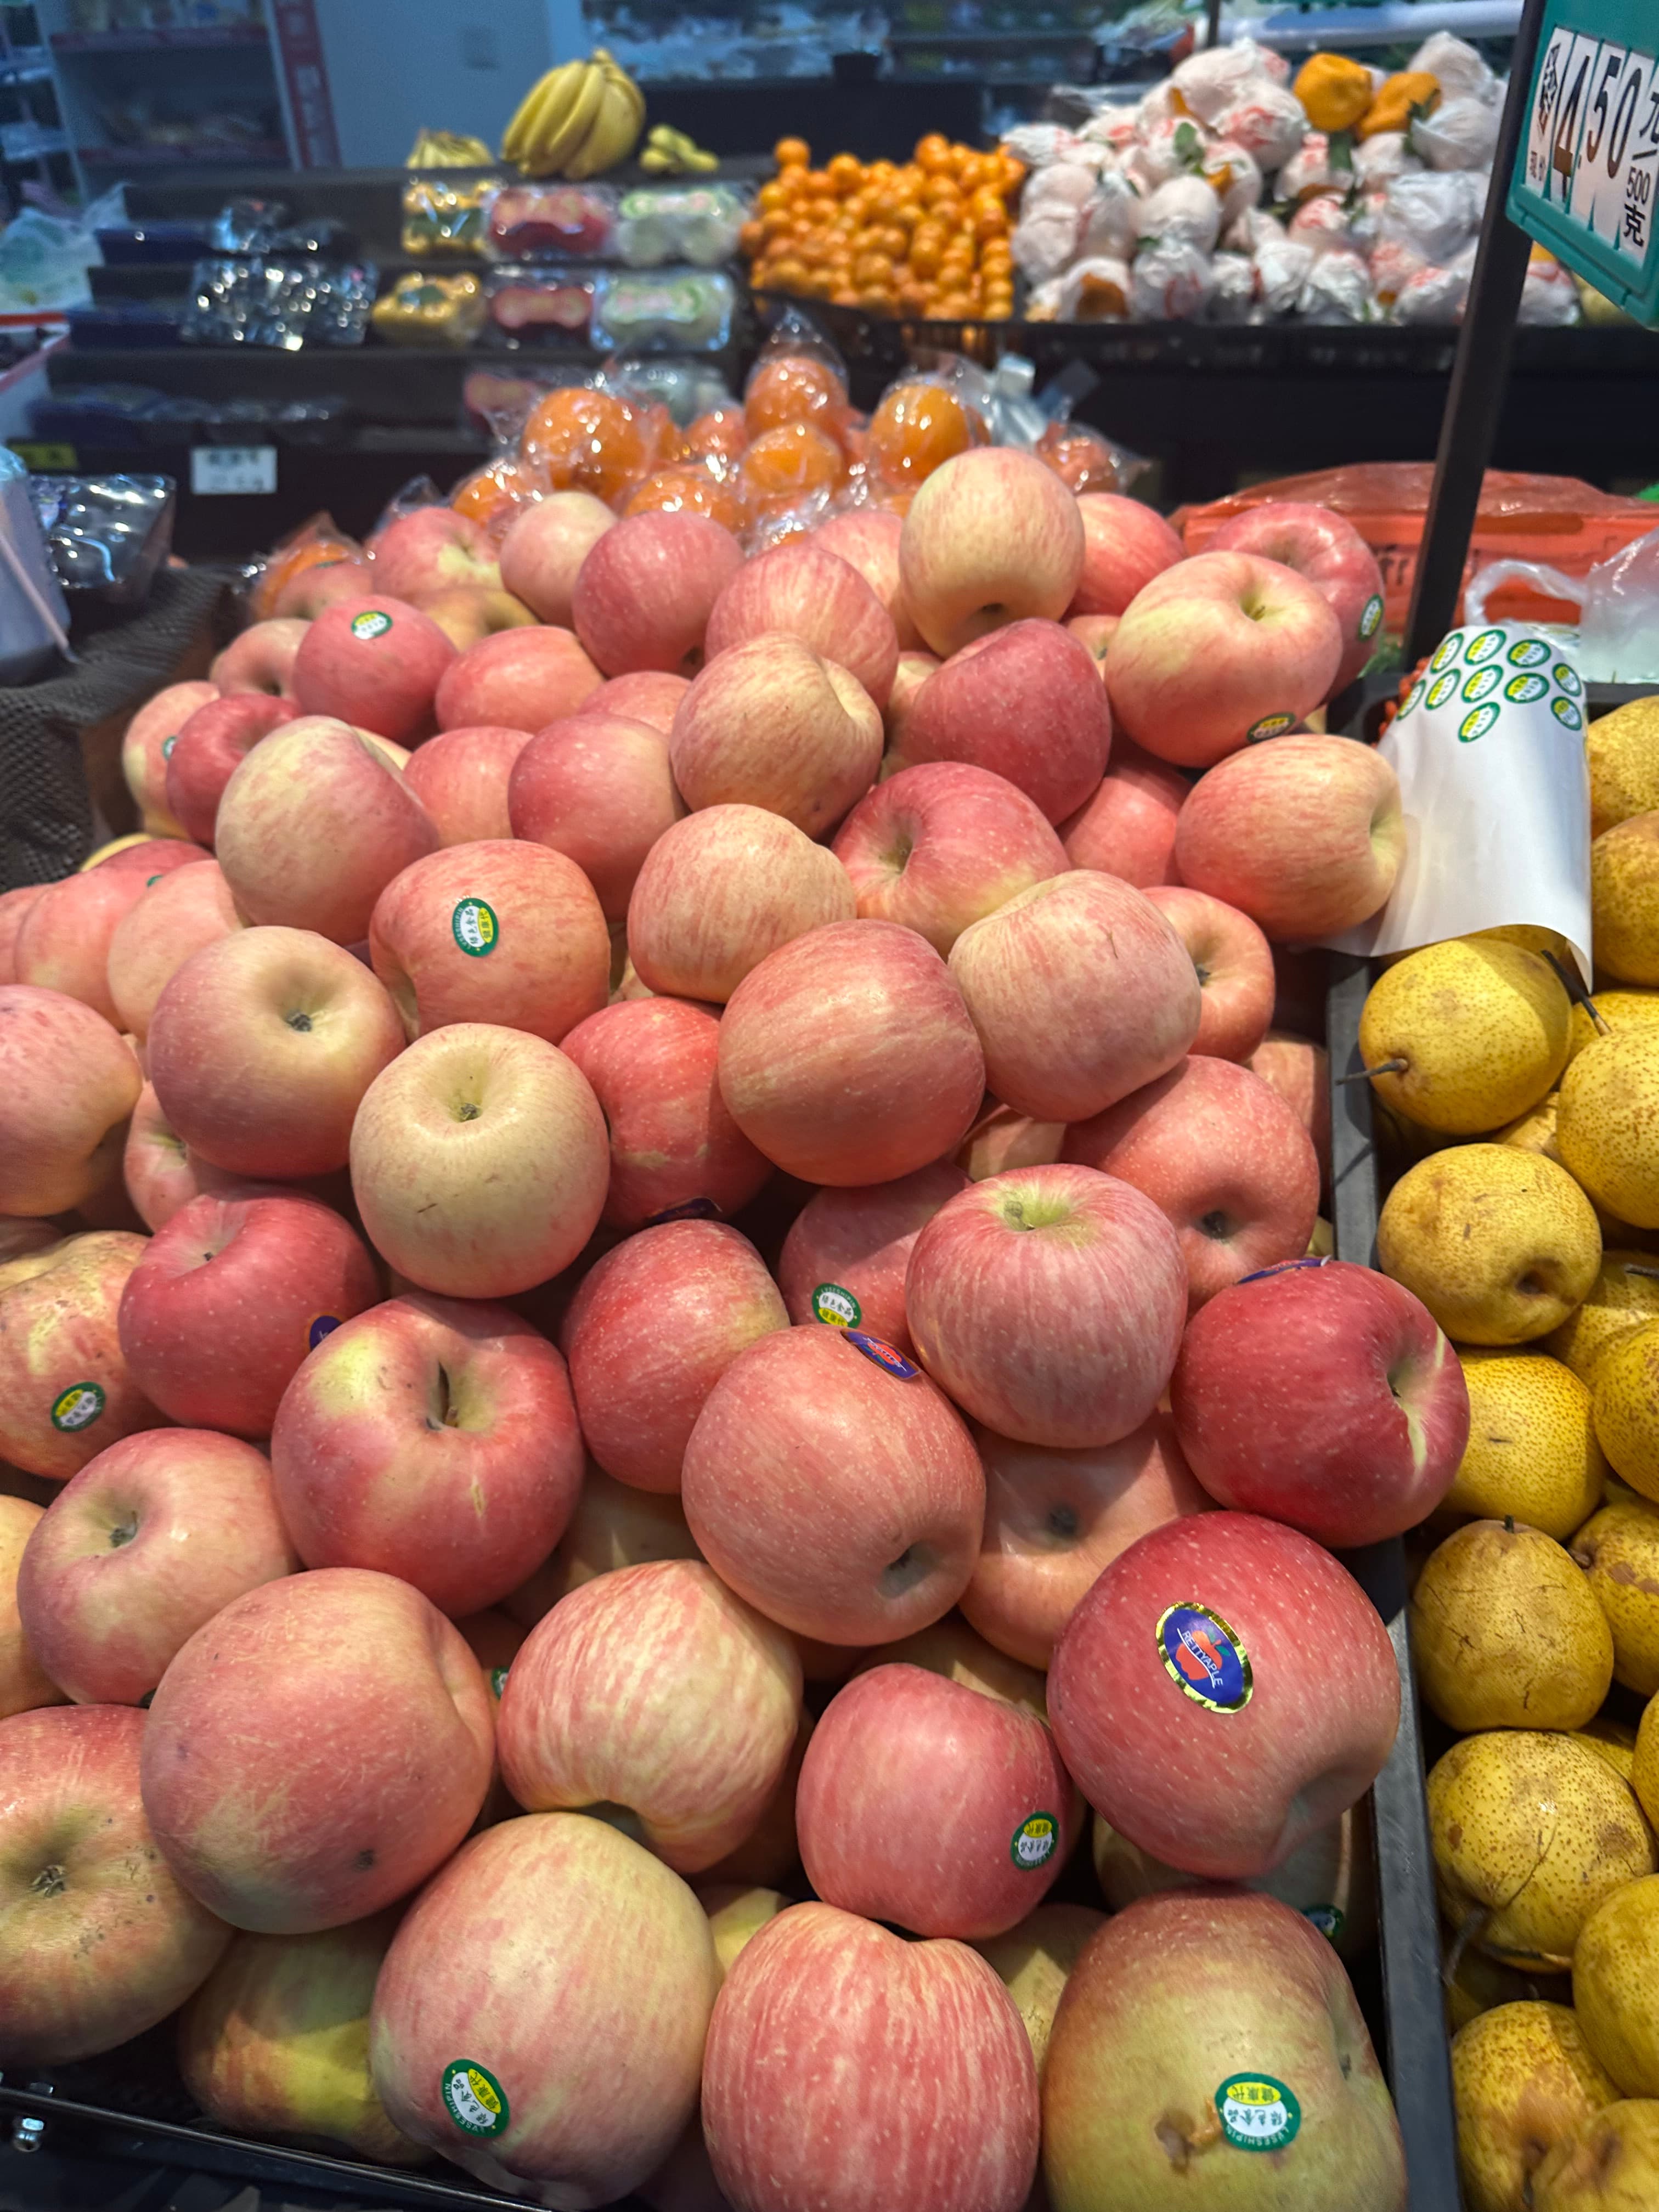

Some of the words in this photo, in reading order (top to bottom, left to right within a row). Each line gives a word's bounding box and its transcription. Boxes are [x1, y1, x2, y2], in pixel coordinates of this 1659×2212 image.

[1554, 55, 1642, 204] 4.50
[465, 909, 478, 944] 绿色食品
[822, 1295, 851, 1316] 绿色食品
[453, 2079, 488, 2124] 绿色食品
[1228, 2108, 1282, 2126] 绿色食品
